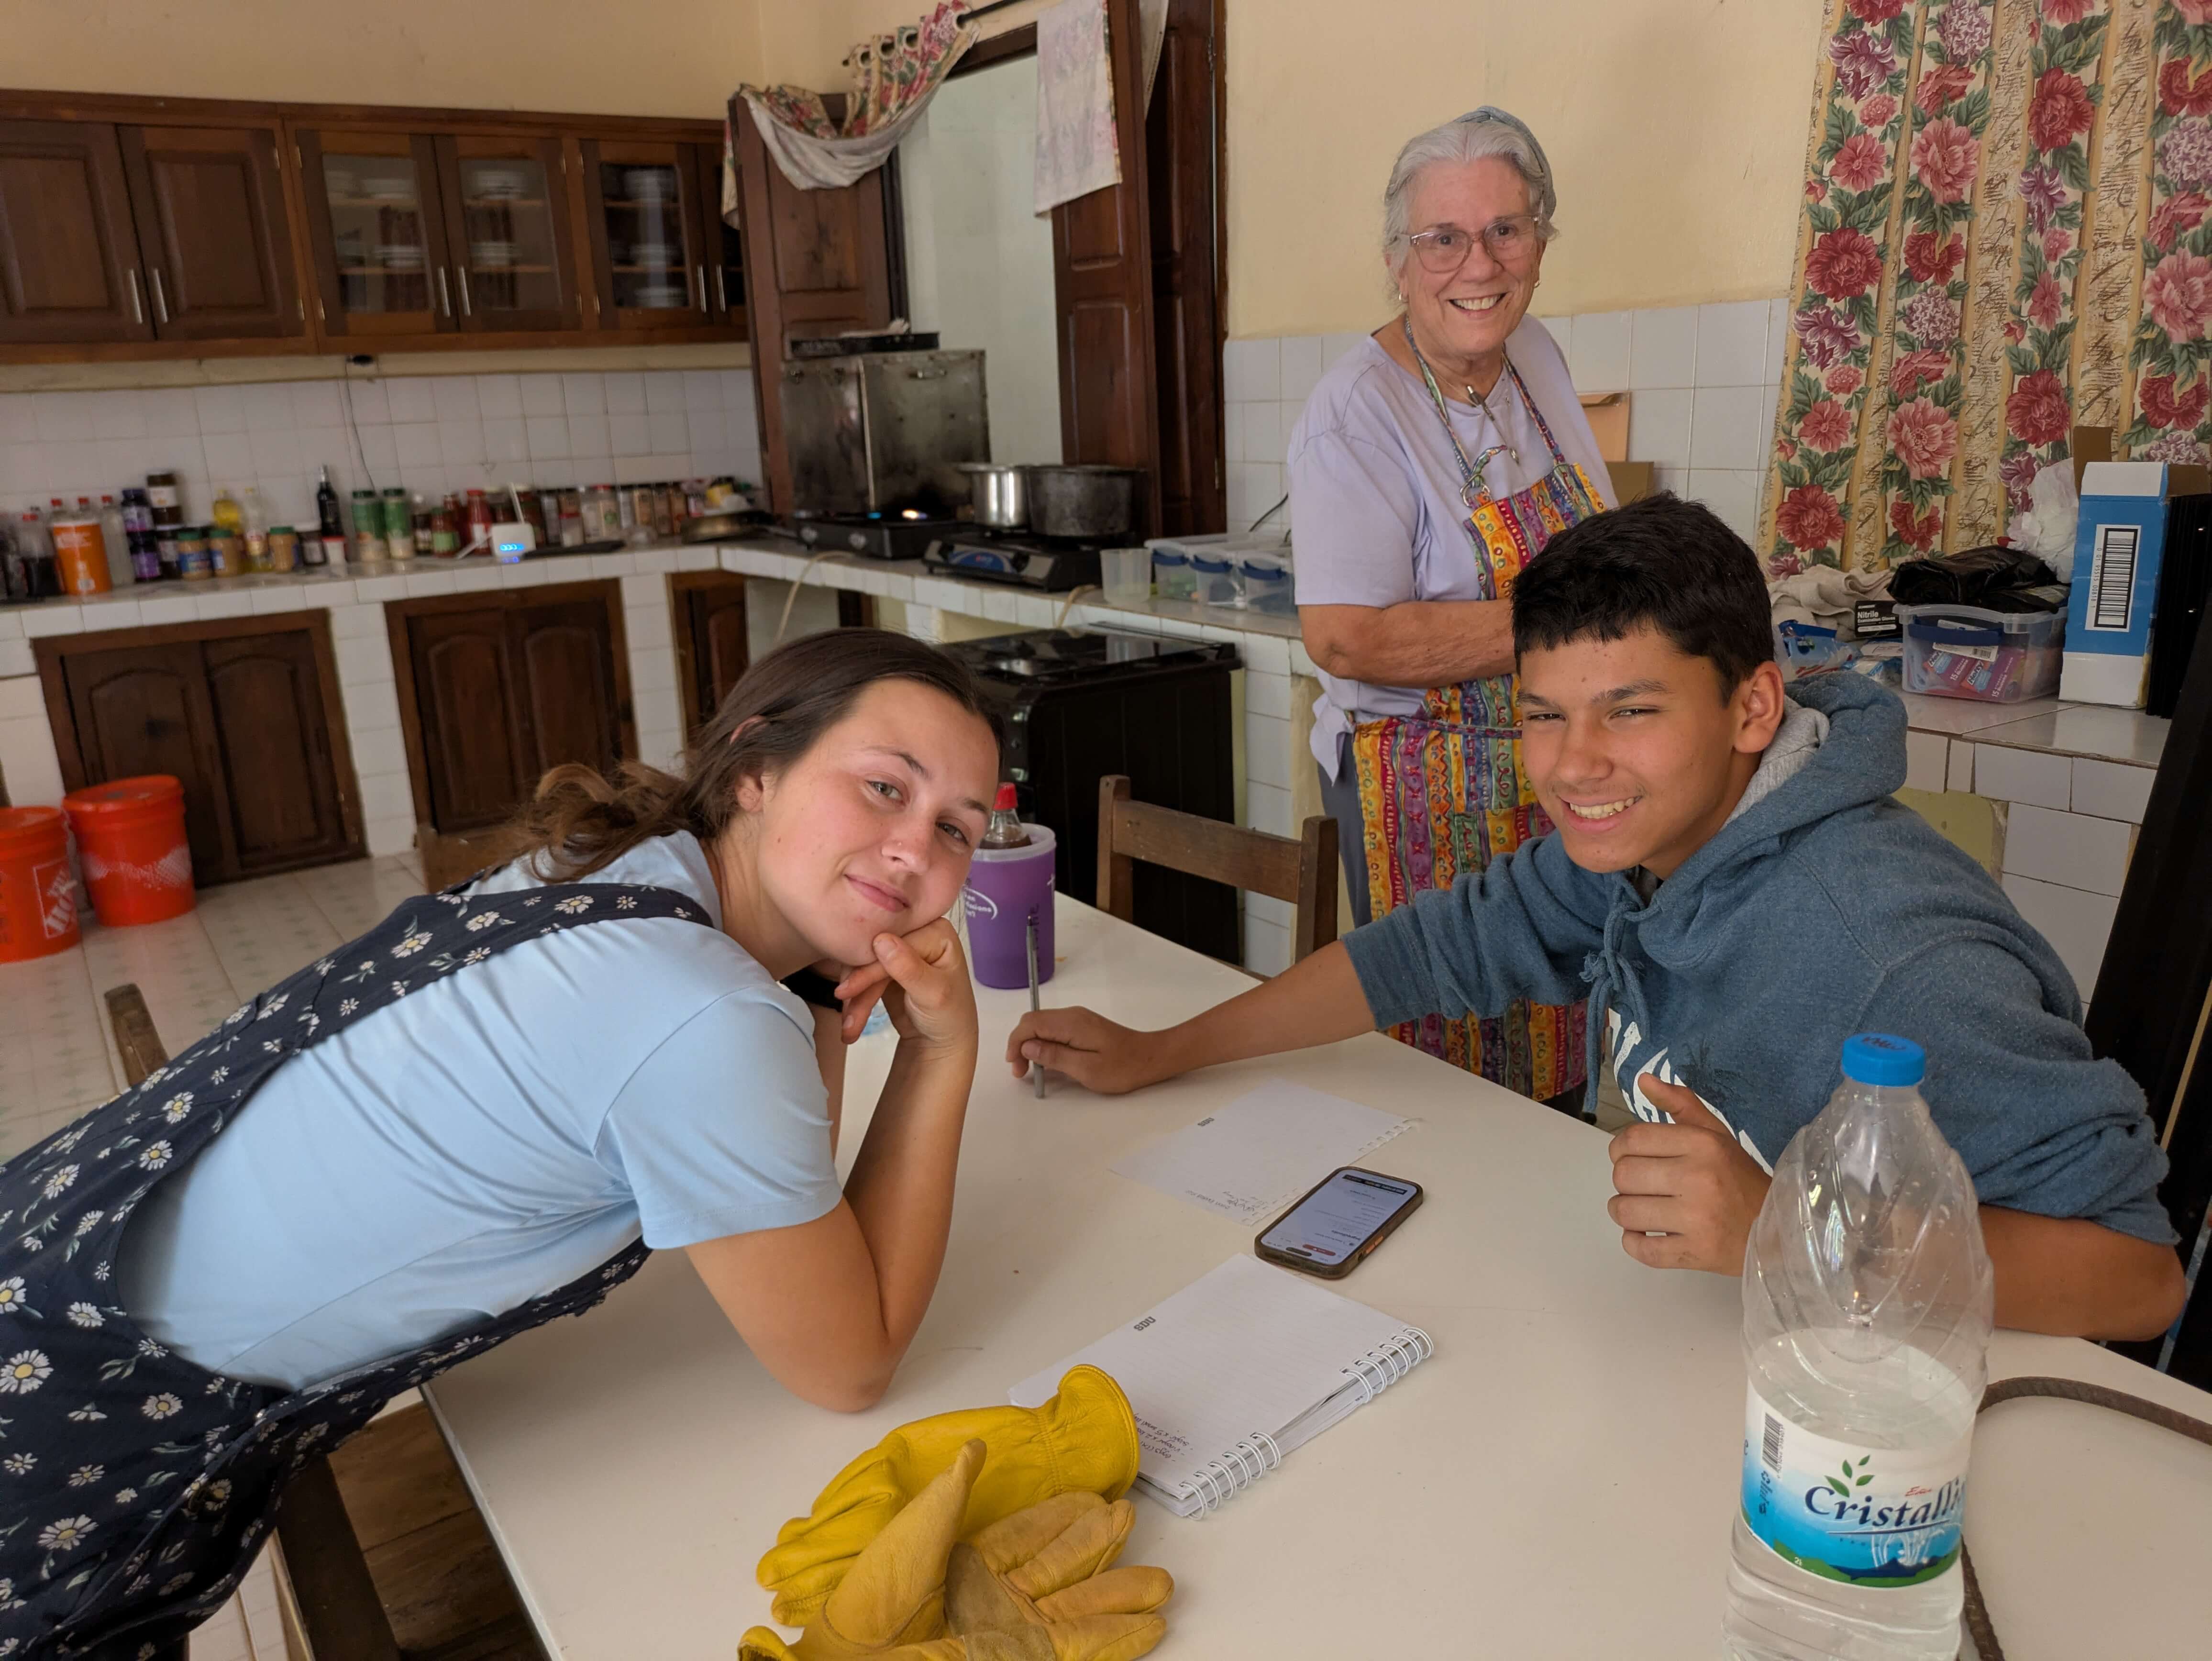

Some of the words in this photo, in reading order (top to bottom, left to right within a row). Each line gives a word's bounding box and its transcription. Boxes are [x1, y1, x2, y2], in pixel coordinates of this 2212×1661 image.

[1857, 610, 1879, 619] Nitrile
[1950, 673, 1959, 681] 15
[1991, 689, 2000, 698] 15
[1133, 1316, 1157, 1331] SDU
[1804, 1475, 1965, 1527] Cristalli
